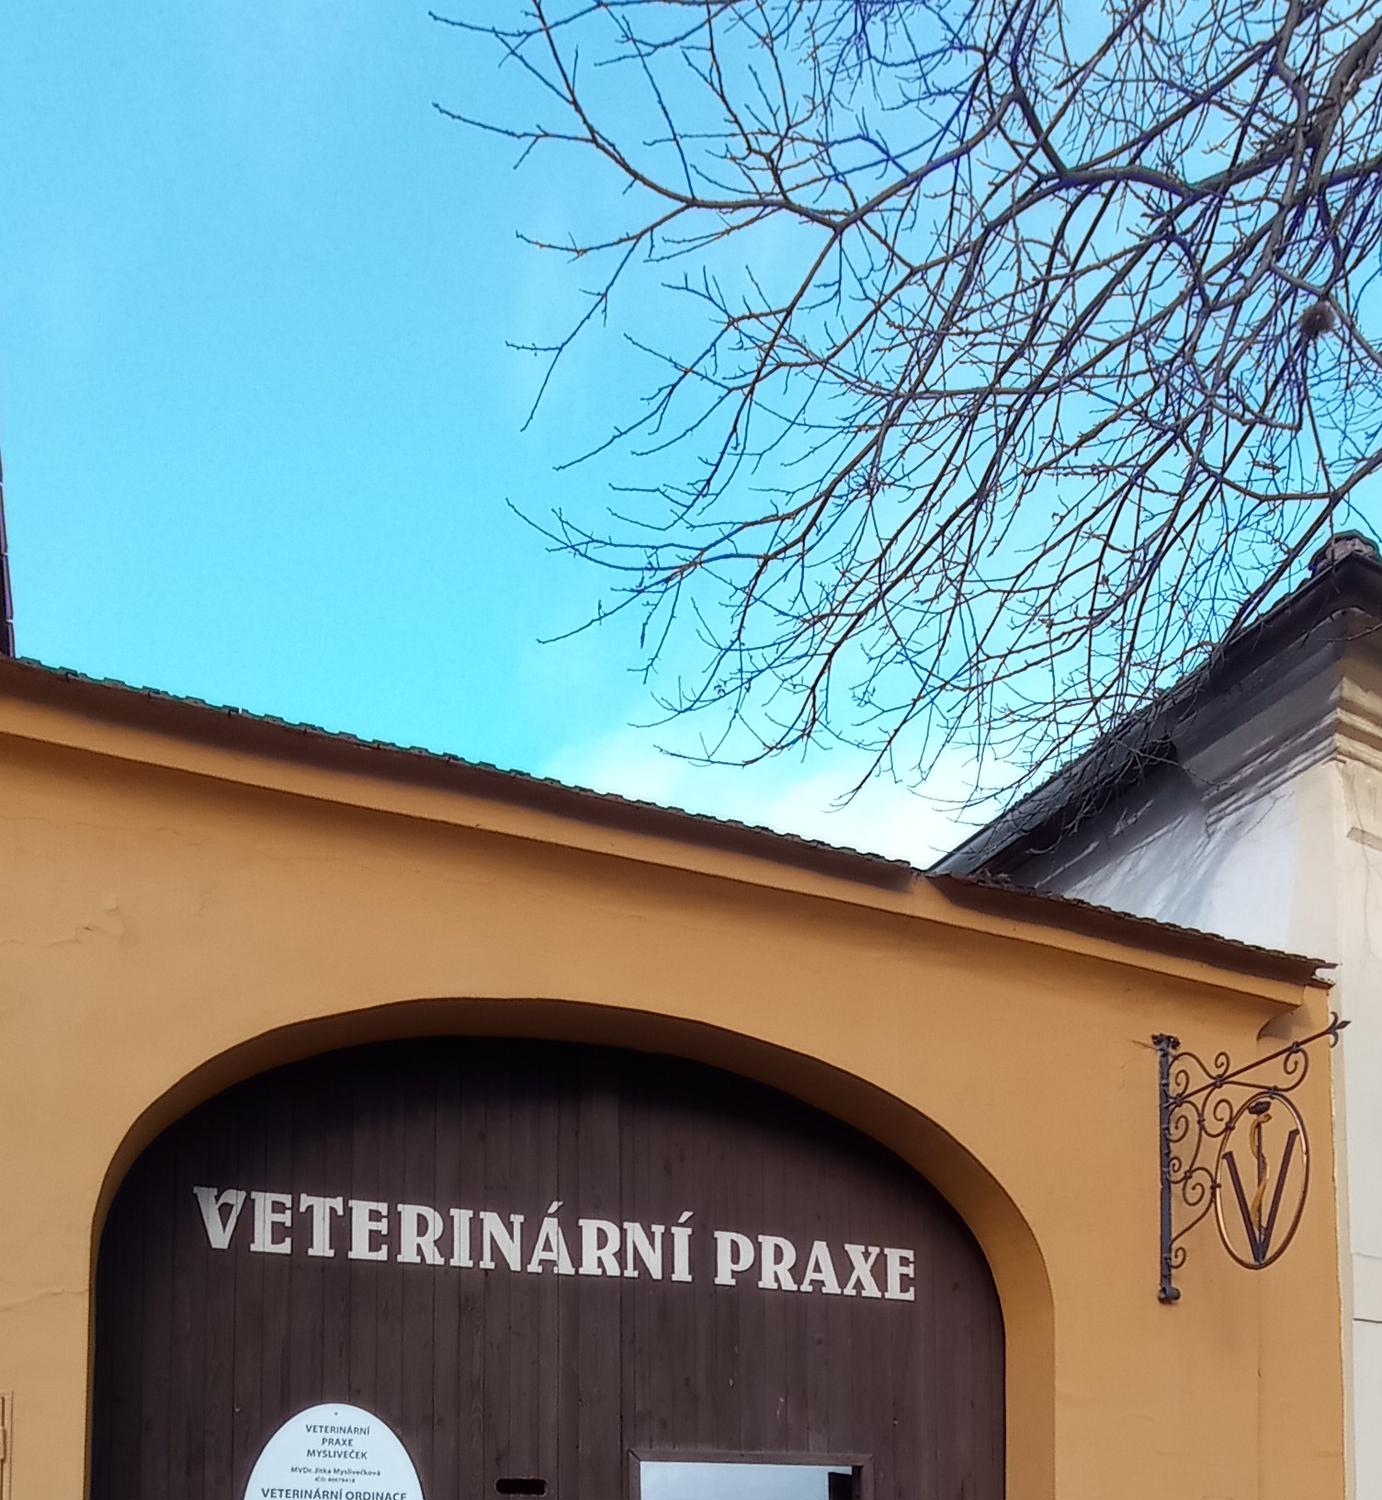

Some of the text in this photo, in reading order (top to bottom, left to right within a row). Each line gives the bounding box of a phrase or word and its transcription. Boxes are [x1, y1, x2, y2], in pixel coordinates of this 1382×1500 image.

[193, 1186, 916, 1302] VETERINÁRNÍ PRAXE
[305, 1424, 370, 1435] VETERINÁRNÍ
[321, 1437, 353, 1447] PRAXE
[306, 1449, 367, 1460] MYSLIVEČEK
[261, 1488, 342, 1500] VETERINÁRNÍ
